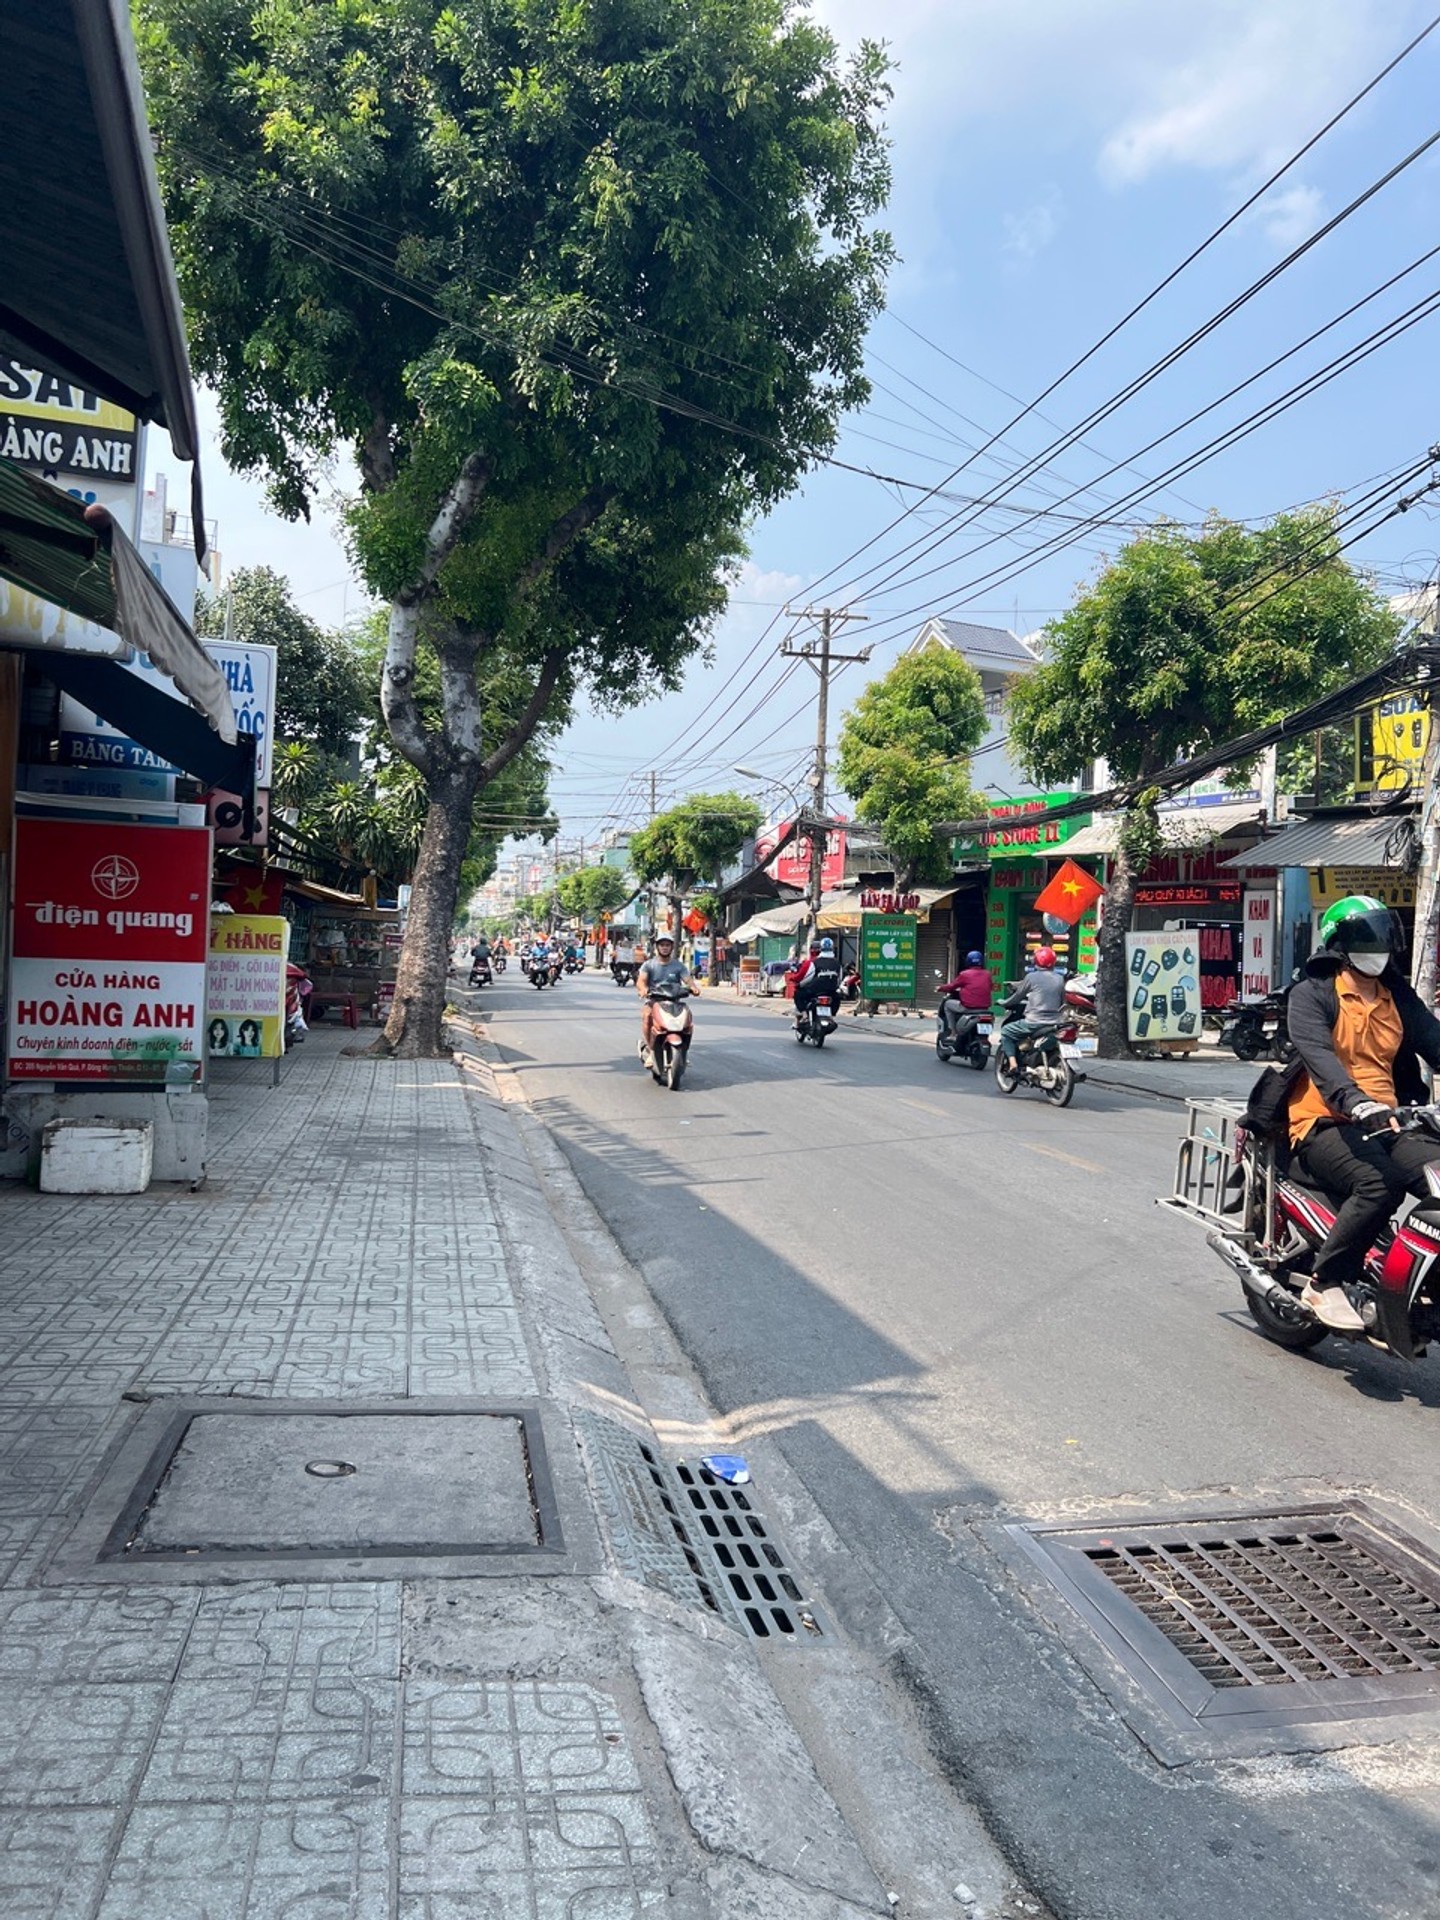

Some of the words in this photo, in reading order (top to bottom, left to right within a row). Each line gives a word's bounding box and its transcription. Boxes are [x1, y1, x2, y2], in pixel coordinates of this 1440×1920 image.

[0, 417, 63, 464] ÀNG
[69, 436, 132, 473] ANH
[71, 737, 126, 764] BĂNG
[25, 901, 99, 928] điện
[106, 911, 193, 937] quang
[1248, 895, 1271, 921] KHÁM
[224, 925, 282, 951] HẰNG
[56, 968, 96, 989] CỬA
[104, 971, 160, 992] HÀNG
[17, 995, 123, 1028] HOÀNG
[133, 1003, 195, 1029] ANH
[17, 1036, 55, 1053] Chuyên
[57, 1036, 80, 1051] kinh
[82, 1037, 114, 1052] doanh
[116, 1038, 139, 1054] điện
[1408, 1214, 1440, 1242] YAMAH
